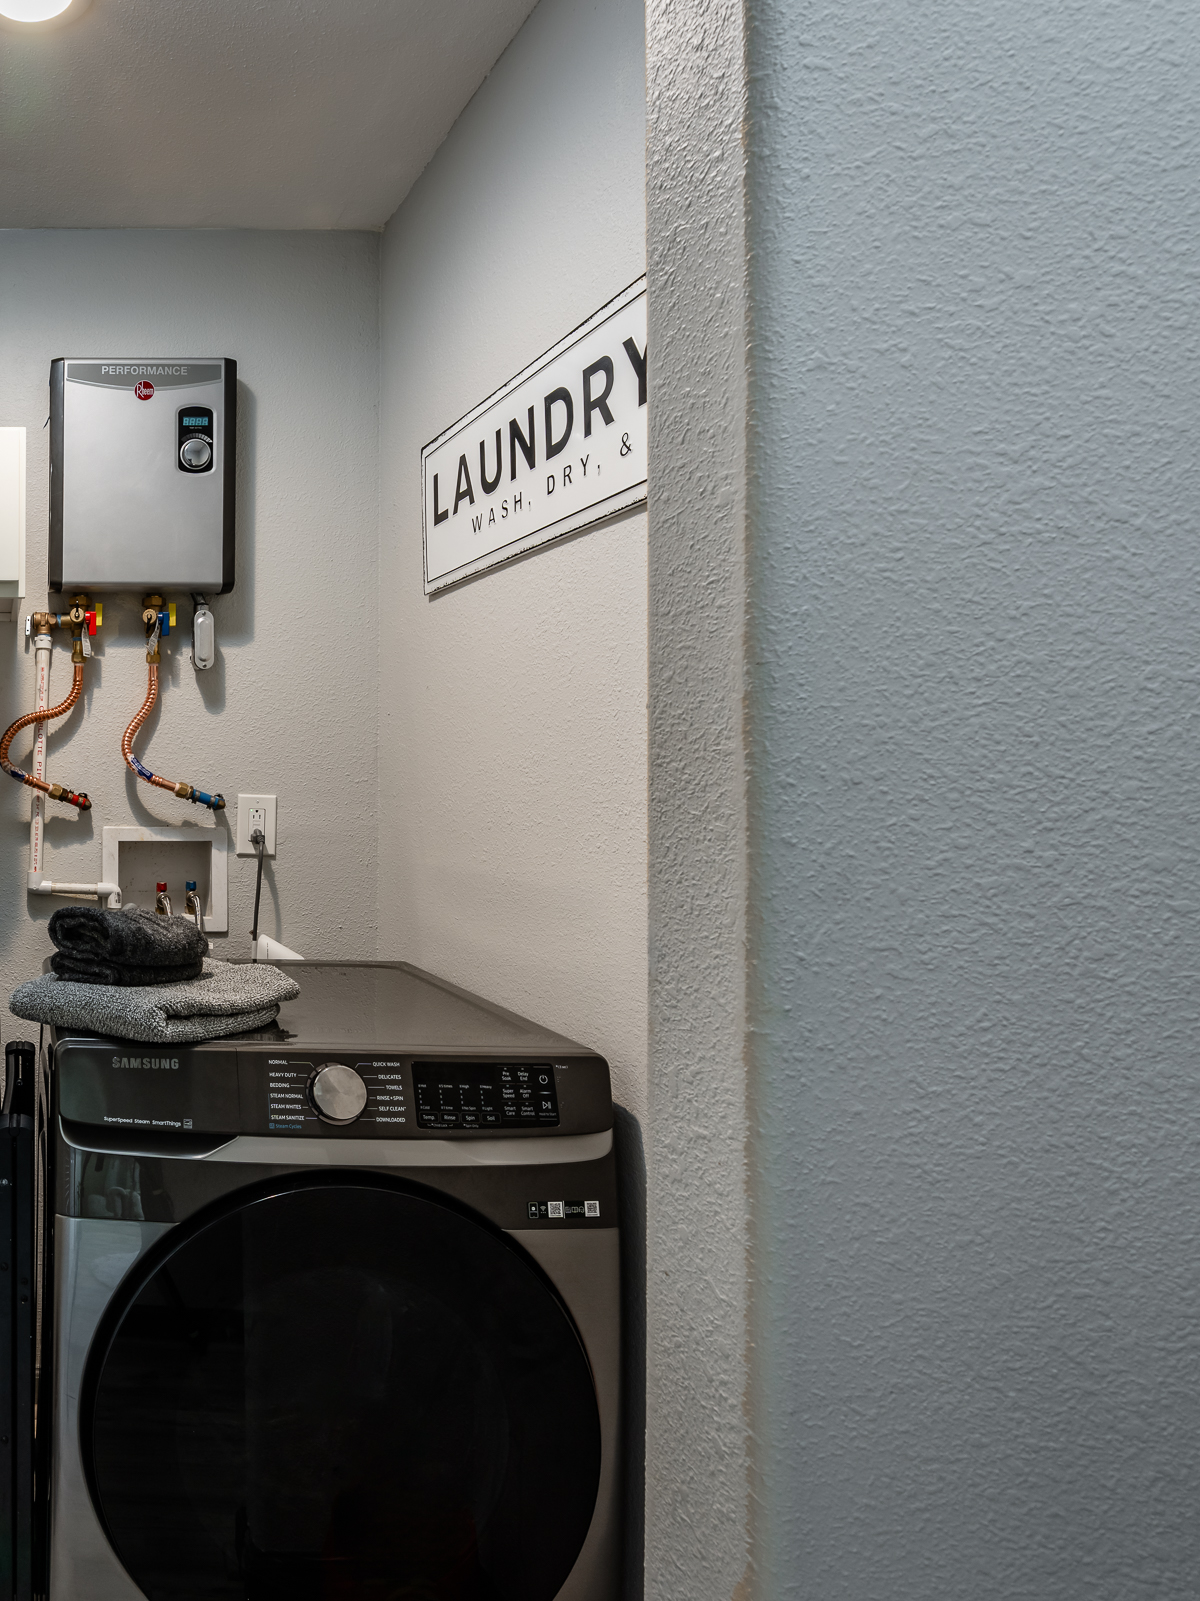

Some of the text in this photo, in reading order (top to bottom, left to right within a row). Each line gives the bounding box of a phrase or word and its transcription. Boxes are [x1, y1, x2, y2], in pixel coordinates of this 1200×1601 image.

[101, 366, 188, 375] PERFORMANCE
[136, 381, 154, 398] Rheem
[433, 336, 647, 526] LAUNDRY
[471, 432, 632, 533] WASH, DRY, &
[112, 1057, 179, 1070] SAMSUNG
[103, 1116, 133, 1124] SuperSpeed
[152, 1120, 182, 1128] SmartThings
